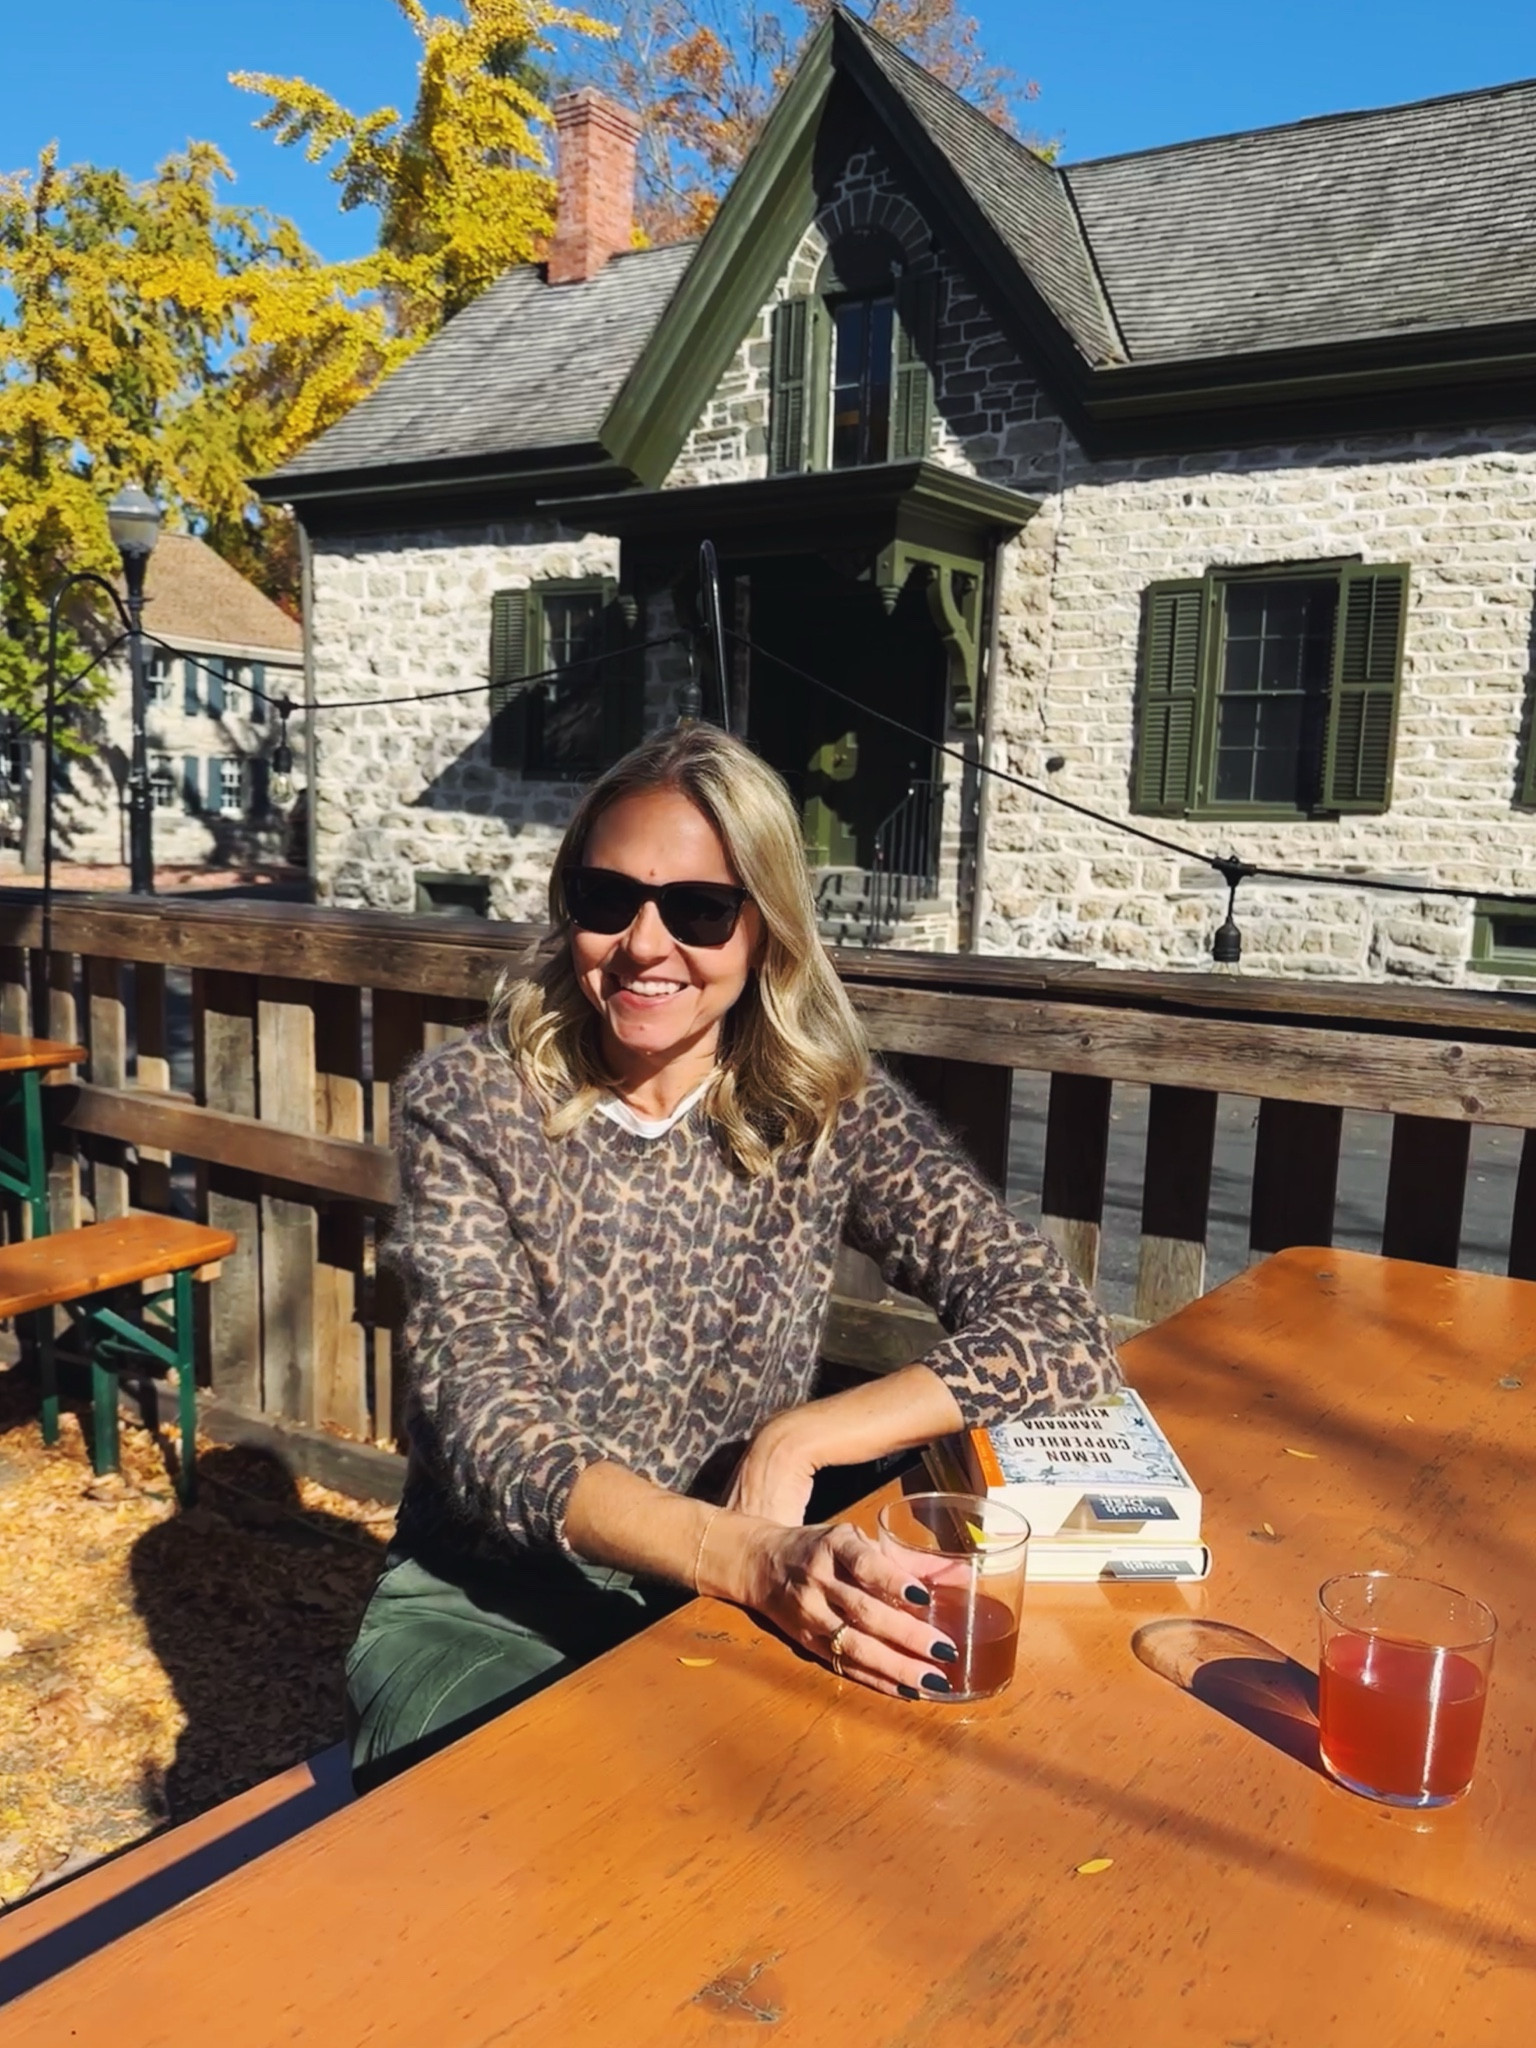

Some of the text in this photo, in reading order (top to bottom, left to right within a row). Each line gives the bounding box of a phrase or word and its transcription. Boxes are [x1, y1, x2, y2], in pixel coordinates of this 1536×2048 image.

[1023, 1419, 1102, 1430] BARBARA
[1013, 1437, 1130, 1450] COPPERHEAD
[1046, 1451, 1111, 1463] DEMON
[1105, 1503, 1163, 1516] Rough
[1123, 1560, 1180, 1572] Rough
